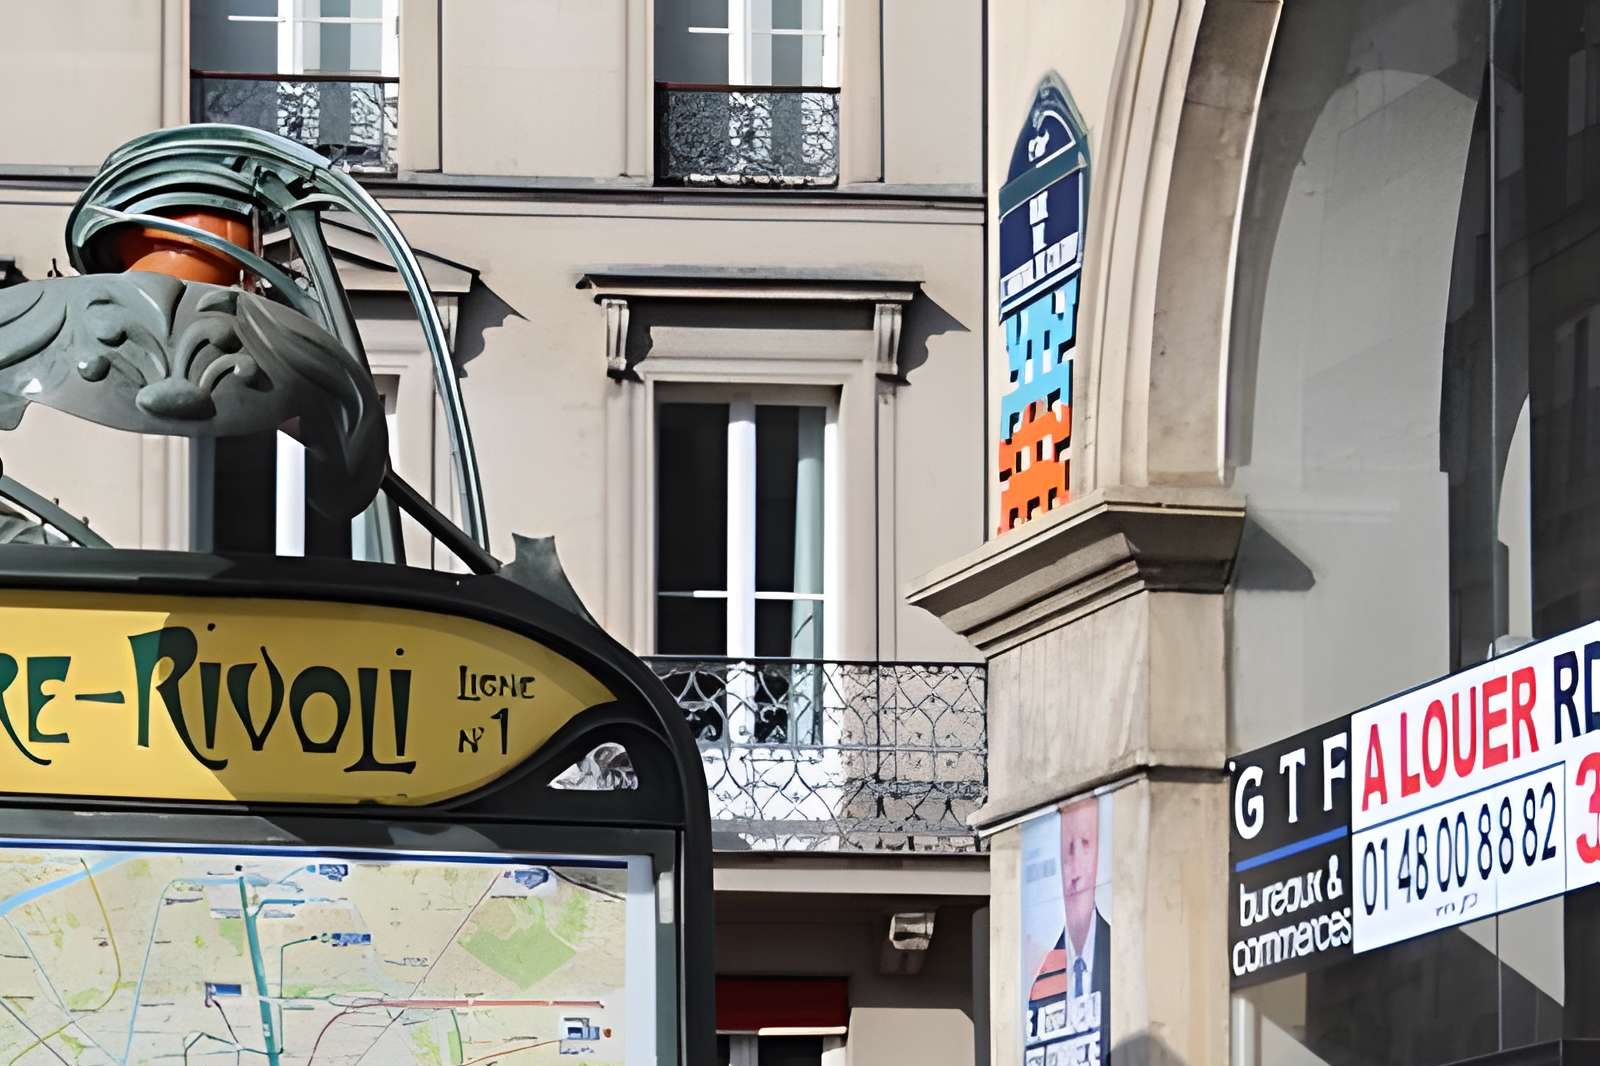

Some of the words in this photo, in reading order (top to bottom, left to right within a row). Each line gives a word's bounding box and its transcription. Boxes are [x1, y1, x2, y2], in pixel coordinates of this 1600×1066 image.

[1361, 723, 1389, 812] A
[1400, 665, 1540, 798] LOUER
[1239, 868, 1323, 928] bureaux
[1326, 854, 1344, 901] &
[1232, 906, 1353, 977] commerces
